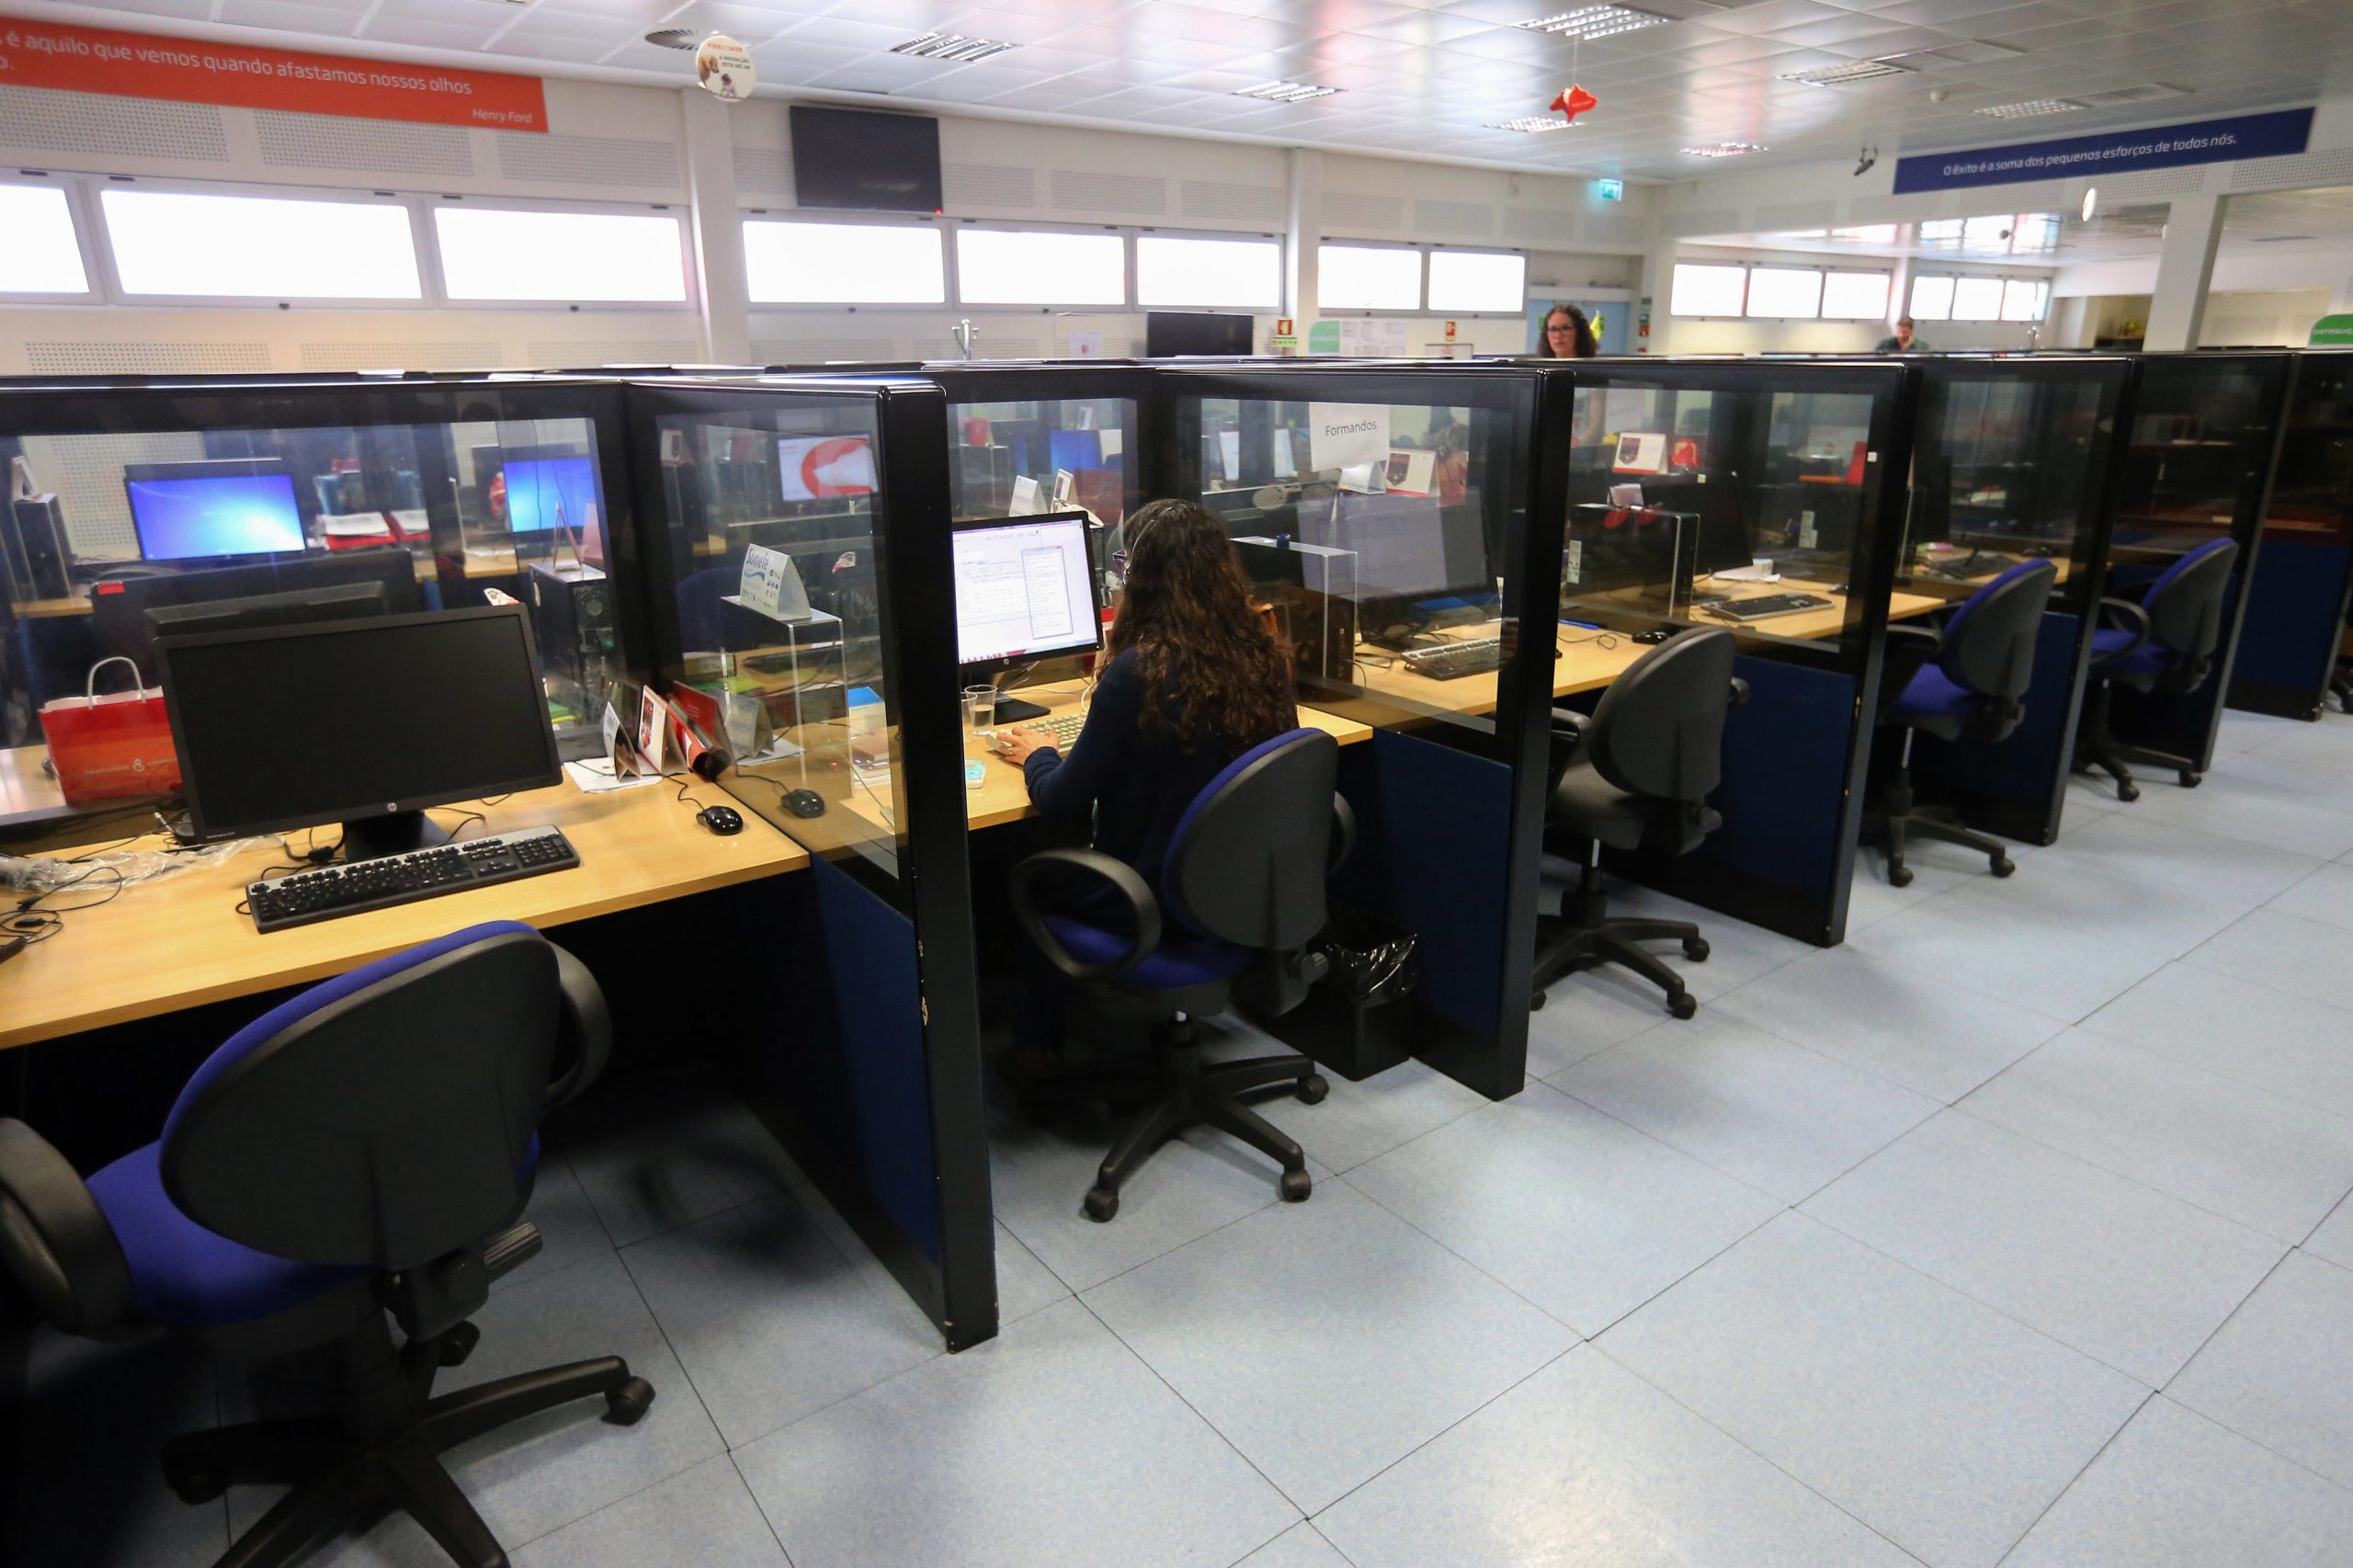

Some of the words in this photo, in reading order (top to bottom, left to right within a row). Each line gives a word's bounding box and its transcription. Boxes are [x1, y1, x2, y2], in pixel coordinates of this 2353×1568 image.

[6, 29, 21, 47] é
[25, 34, 90, 57] aquilo
[94, 43, 133, 62] que
[137, 49, 200, 68] vemos
[203, 53, 274, 75] quando
[277, 61, 368, 85] afastamos
[369, 73, 426, 90] nossos
[430, 75, 472, 95] olhos
[472, 108, 506, 124] Henry
[508, 110, 533, 124] Ford
[1943, 165, 1951, 176] O
[1952, 163, 1977, 175] êxito
[1987, 163, 1995, 171] a
[1995, 159, 2023, 170] soma
[2025, 155, 2044, 167] dos
[2103, 144, 2153, 159] esforços
[2154, 141, 2170, 153] de
[2173, 138, 2208, 151] todos
[2210, 132, 2236, 146] nós.
[1324, 420, 1377, 437] Formandos
